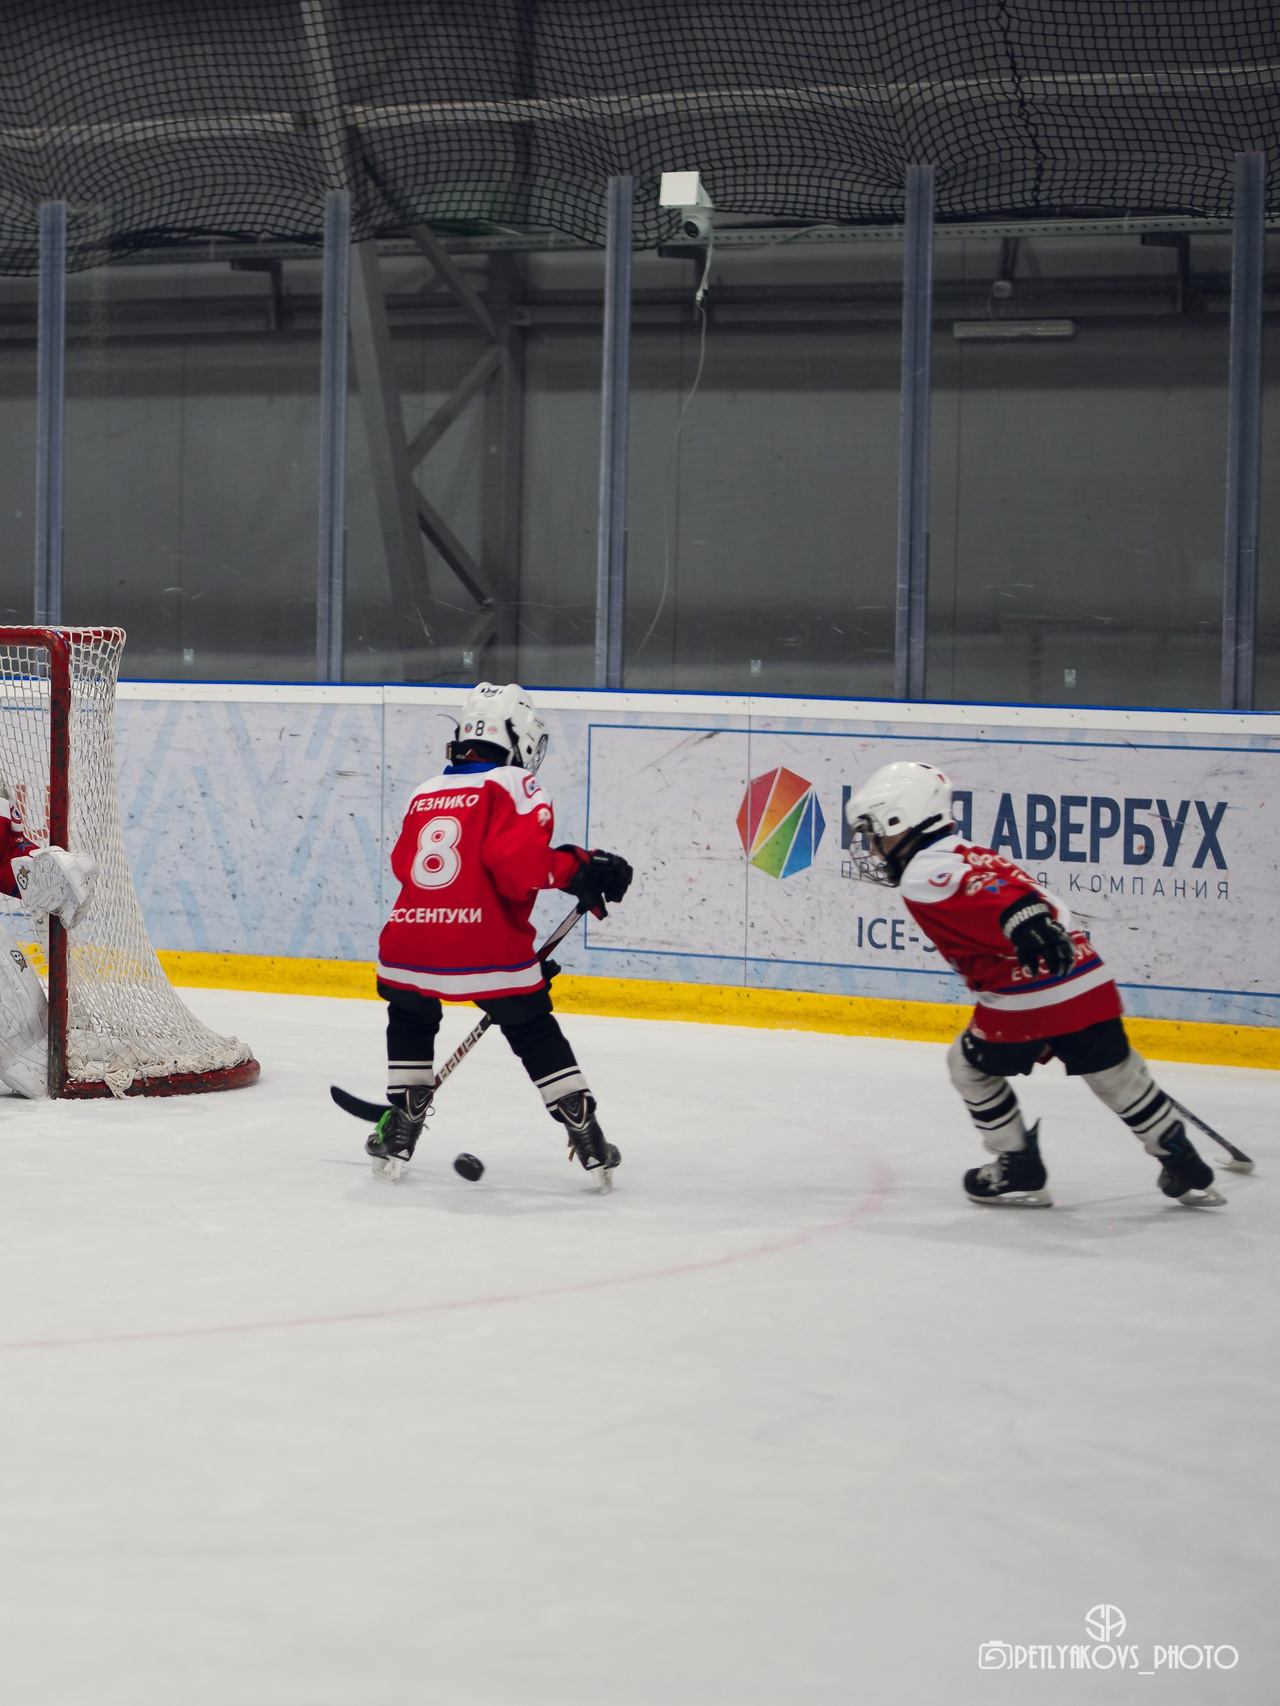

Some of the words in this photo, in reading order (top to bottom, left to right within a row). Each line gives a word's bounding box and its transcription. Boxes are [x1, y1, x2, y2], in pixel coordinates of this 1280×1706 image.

[475, 719, 485, 737] 8
[410, 815, 463, 890] 8
[989, 792, 1229, 871] АВЕРБУХ
[1069, 873, 1229, 900] КОМПАНИЯ
[388, 907, 482, 924] ЕССЕНТУКИ
[438, 1023, 485, 1084] BAUER
